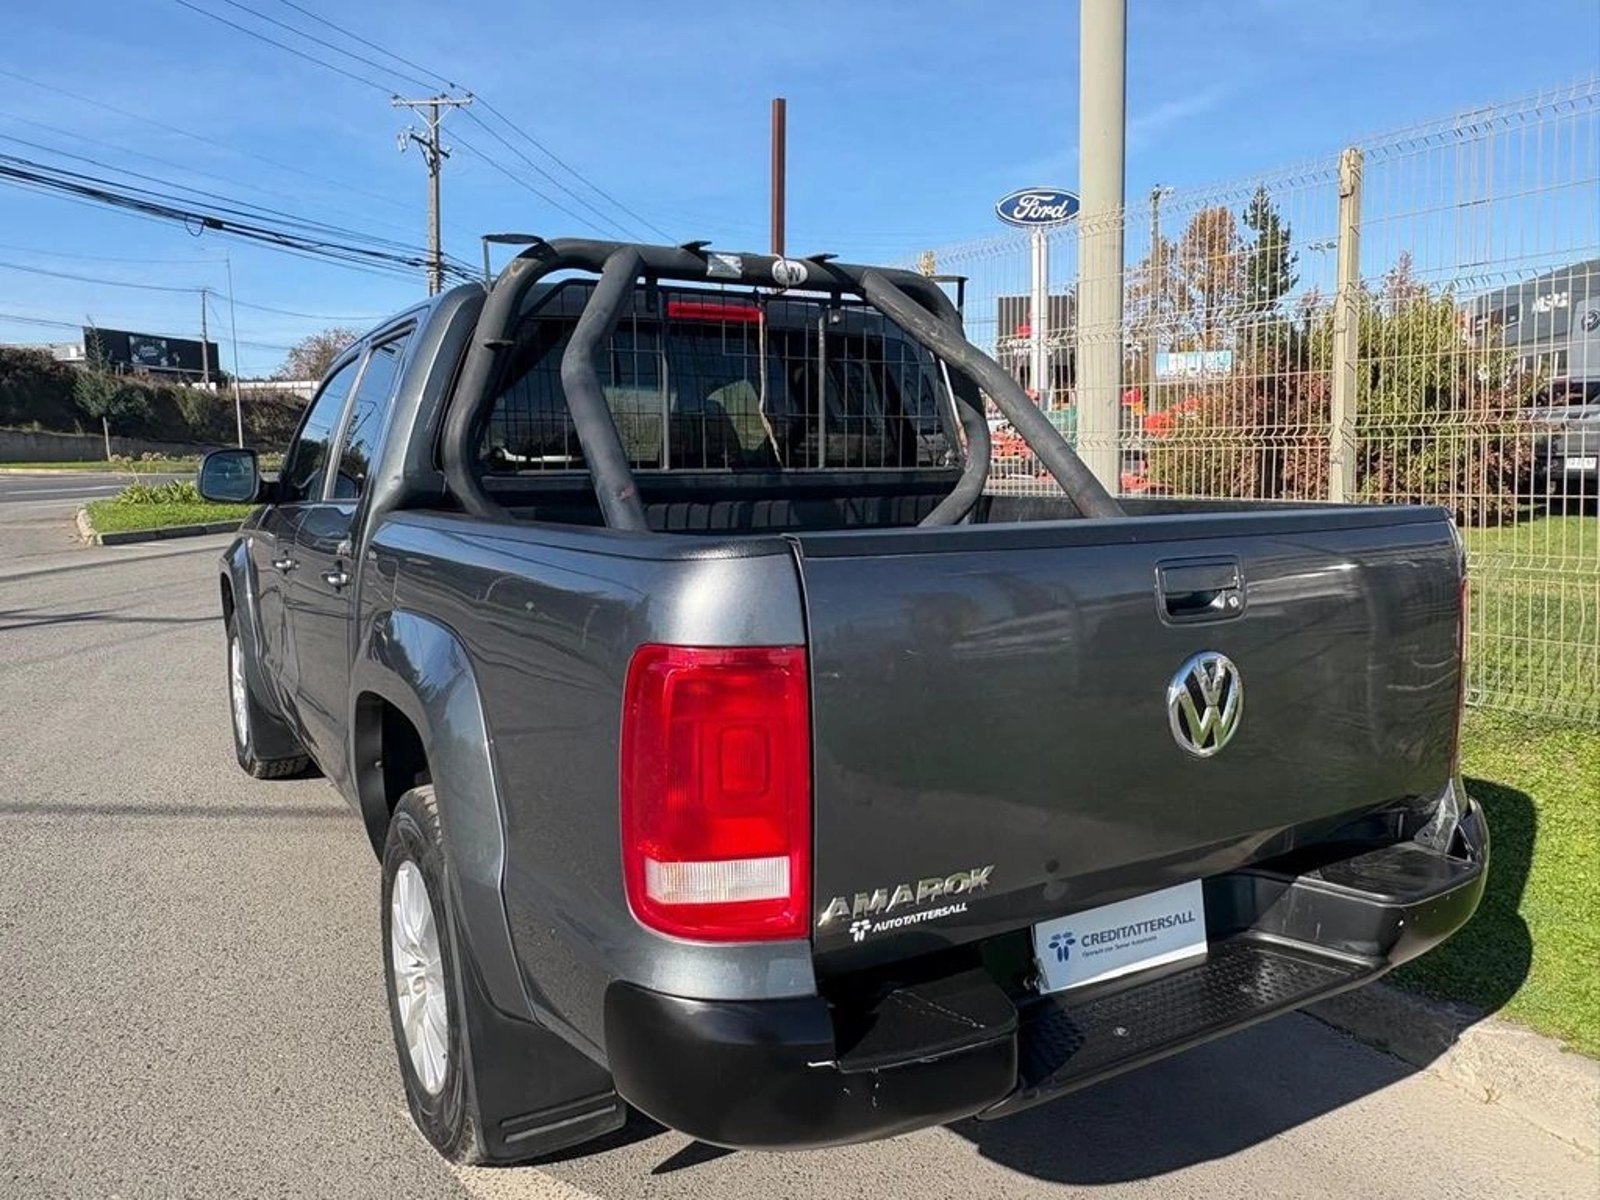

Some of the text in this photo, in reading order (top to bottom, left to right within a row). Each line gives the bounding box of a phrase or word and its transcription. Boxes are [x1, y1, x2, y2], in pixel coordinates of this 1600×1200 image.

[1013, 195, 1069, 219] Ford
[818, 865, 995, 926] AMAROK
[872, 902, 968, 933] AUTOTATTERSALL
[1081, 910, 1196, 948] CREDITATTERSALL
